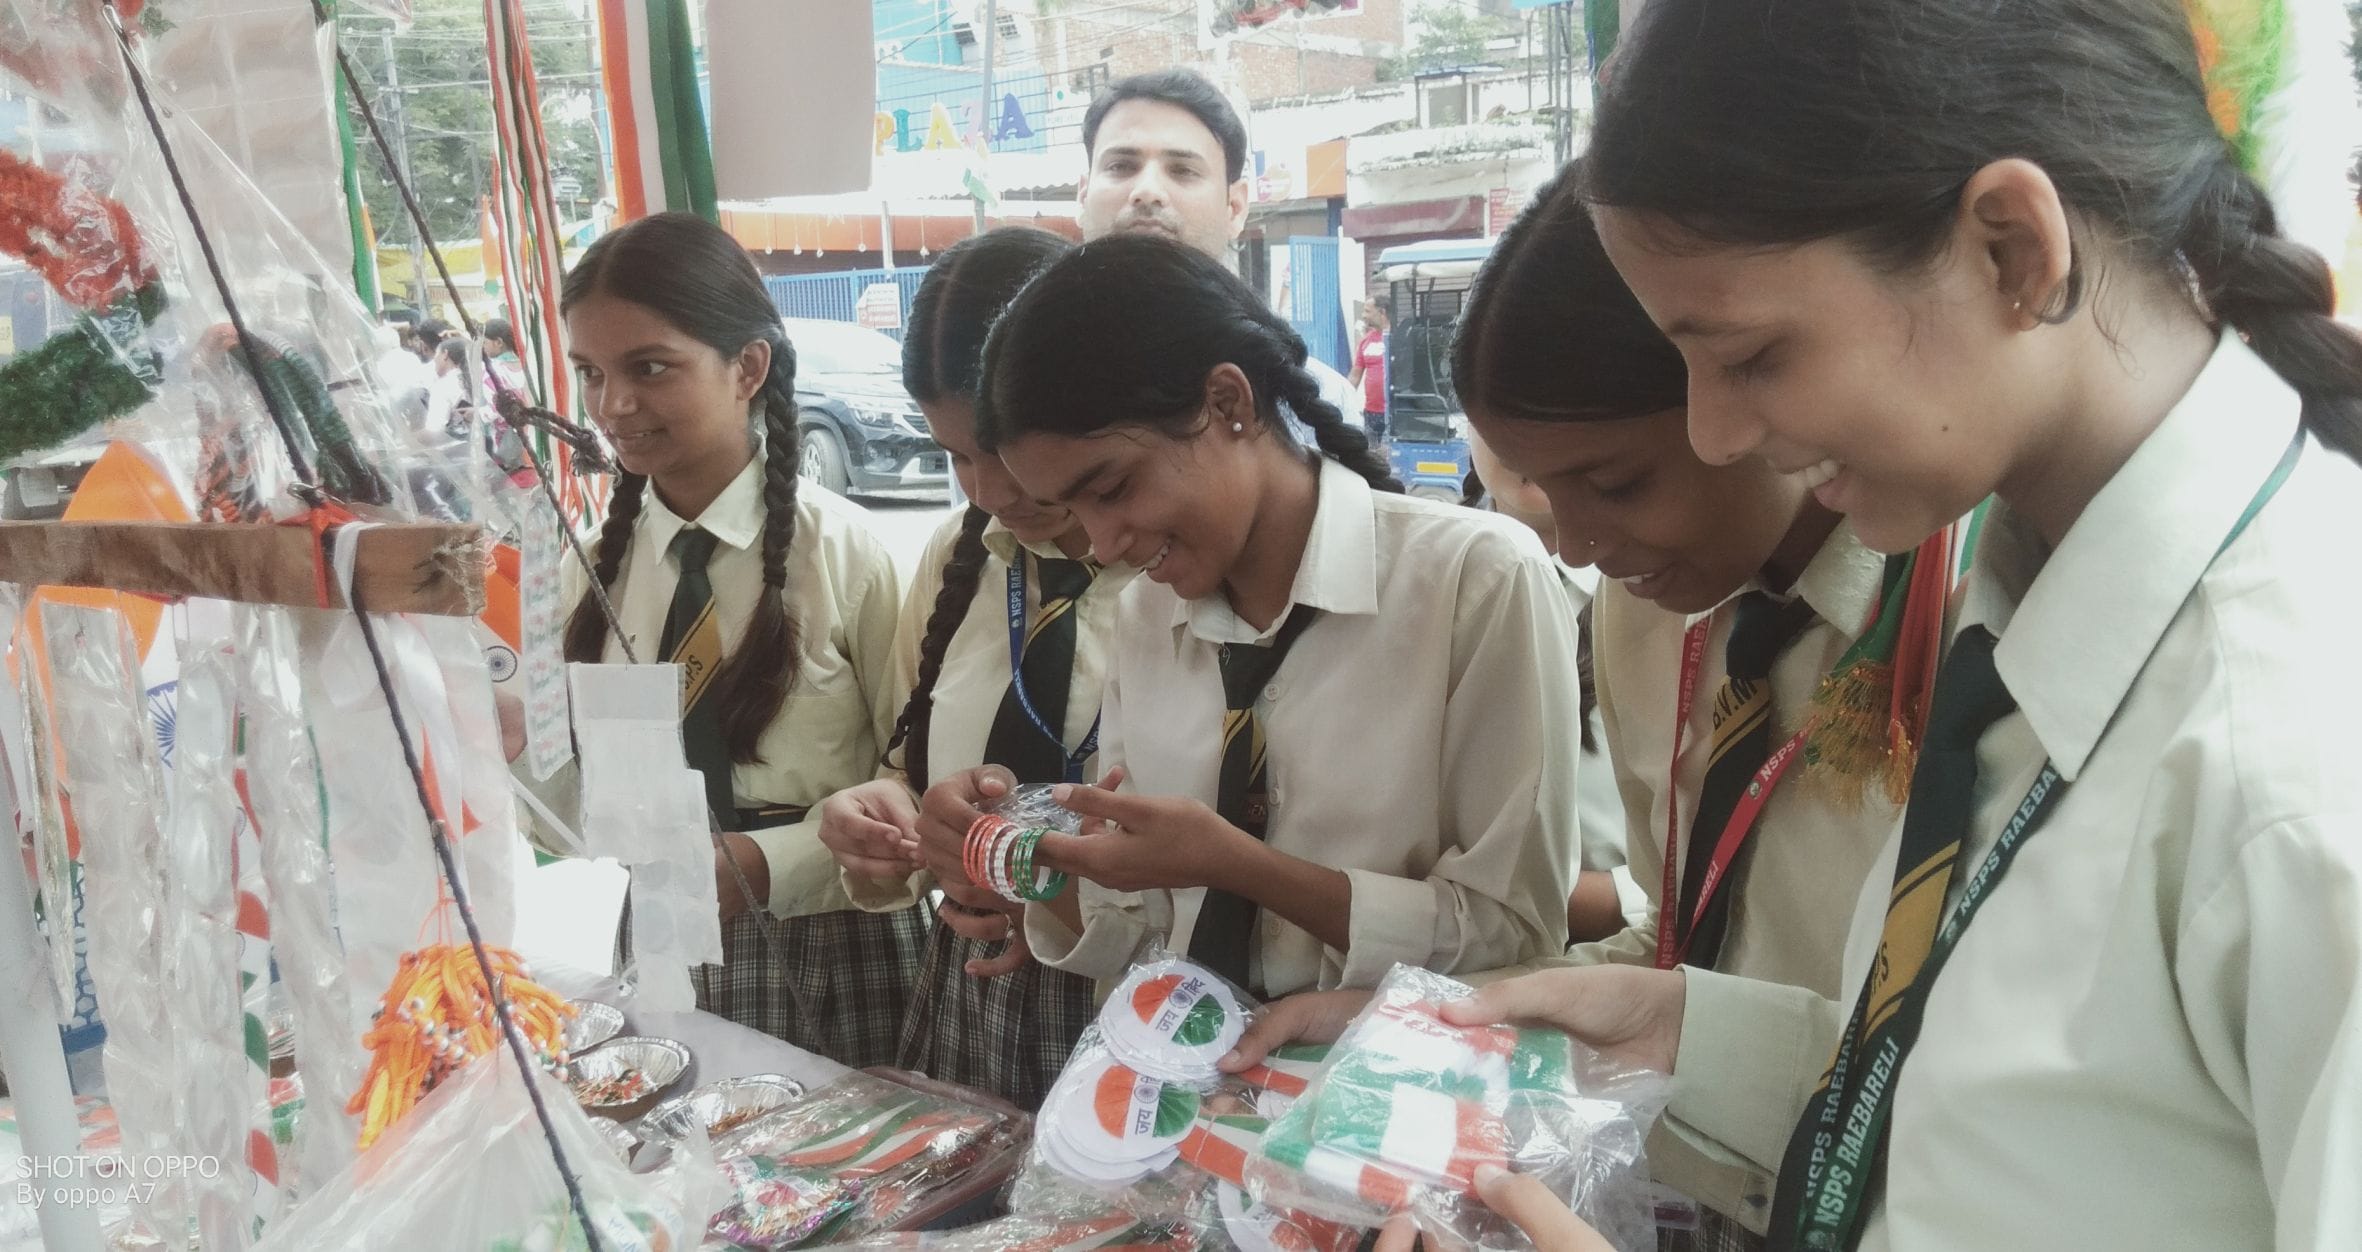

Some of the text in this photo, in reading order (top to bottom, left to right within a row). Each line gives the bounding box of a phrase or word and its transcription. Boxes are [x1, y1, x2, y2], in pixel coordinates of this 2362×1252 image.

[874, 92, 1034, 157] PLAZA
[1011, 590, 1022, 617] NSPS
[1682, 666, 1698, 713] NSPS
[1759, 738, 1797, 781] NSPS
[1956, 850, 2001, 917] NSPS
[1661, 917, 1675, 966] NSPS
[1155, 1009, 1180, 1032] जय
[1134, 1108, 1153, 1136] जय
[1813, 1035, 1901, 1227] NSPS RAEBARELI
